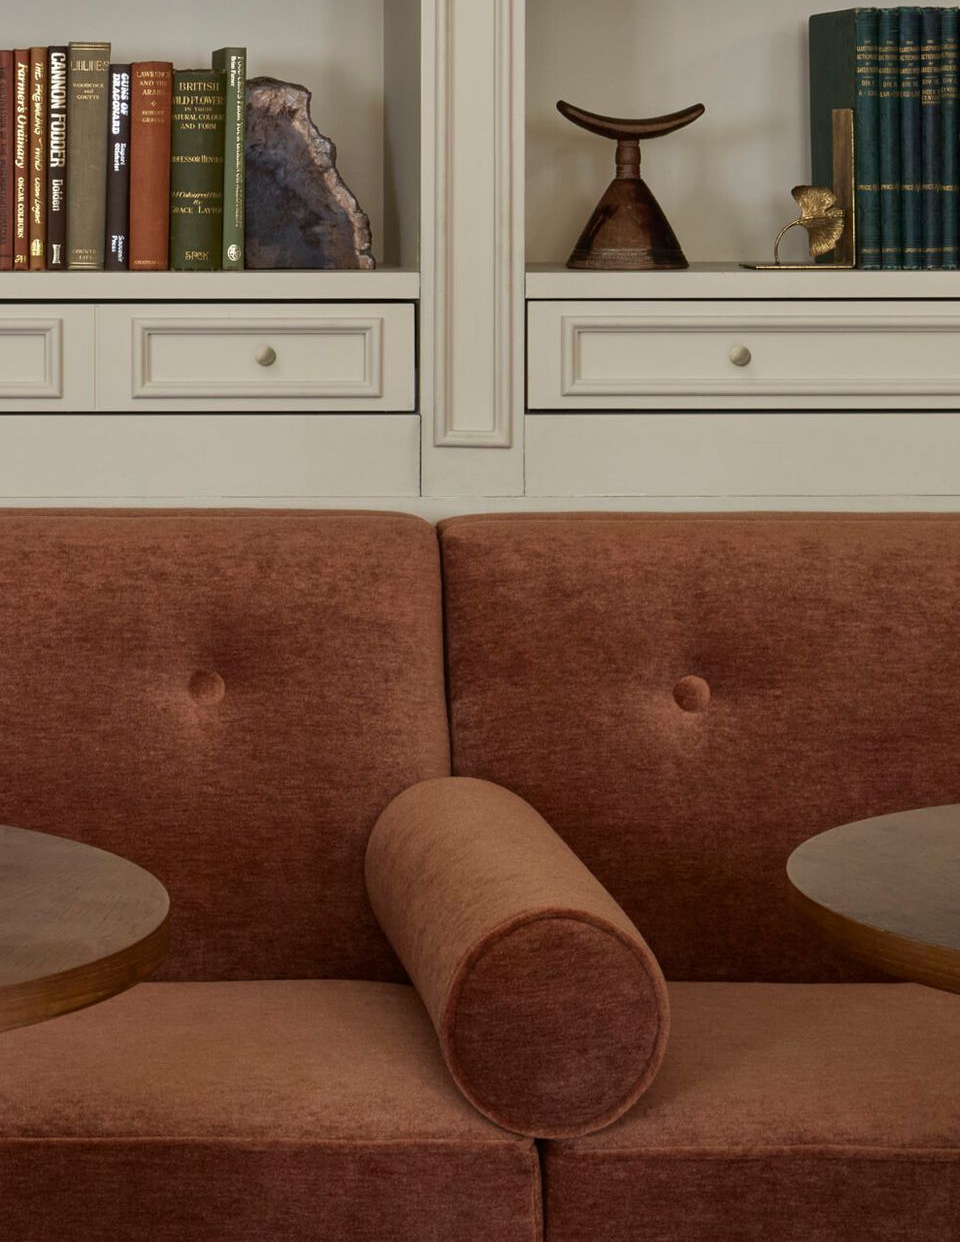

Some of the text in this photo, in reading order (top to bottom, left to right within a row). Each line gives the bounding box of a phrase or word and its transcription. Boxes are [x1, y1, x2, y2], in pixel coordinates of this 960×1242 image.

[15, 62, 28, 169] Farmer's Ordinary
[50, 52, 66, 211] CANNON FODDER Dolden
[112, 73, 121, 134] DRAGONARD
[121, 73, 129, 116] GUNS OF
